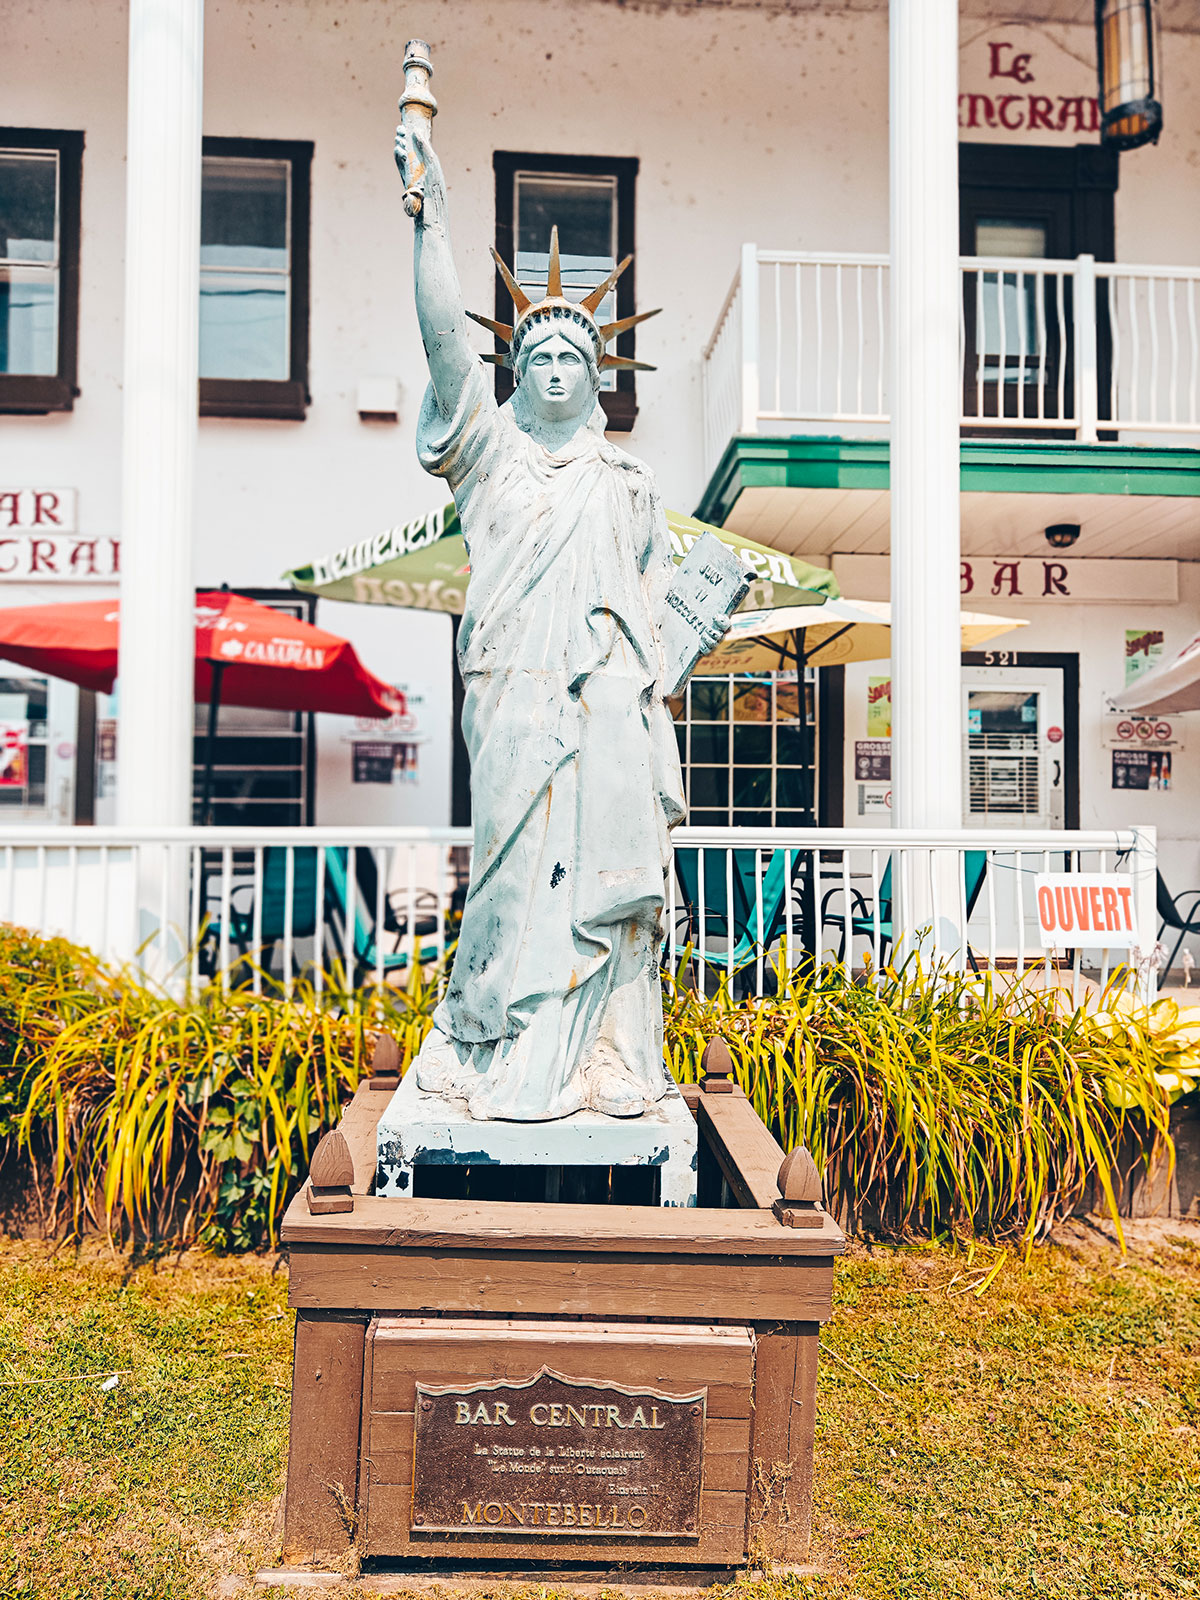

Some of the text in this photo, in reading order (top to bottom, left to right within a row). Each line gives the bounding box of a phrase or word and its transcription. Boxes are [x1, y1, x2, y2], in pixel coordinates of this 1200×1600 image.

[988, 41, 1035, 84] Le
[698, 564, 723, 587] JULY
[244, 641, 326, 669] CANADIAN
[985, 652, 1018, 665] 521
[1038, 886, 1132, 931] OUVERT
[455, 1401, 666, 1430] BAR CENTRAL
[492, 1445, 525, 1458] Statue
[529, 1446, 541, 1458] de
[545, 1446, 555, 1458] la
[460, 1502, 649, 1528] MONTEBELLO
